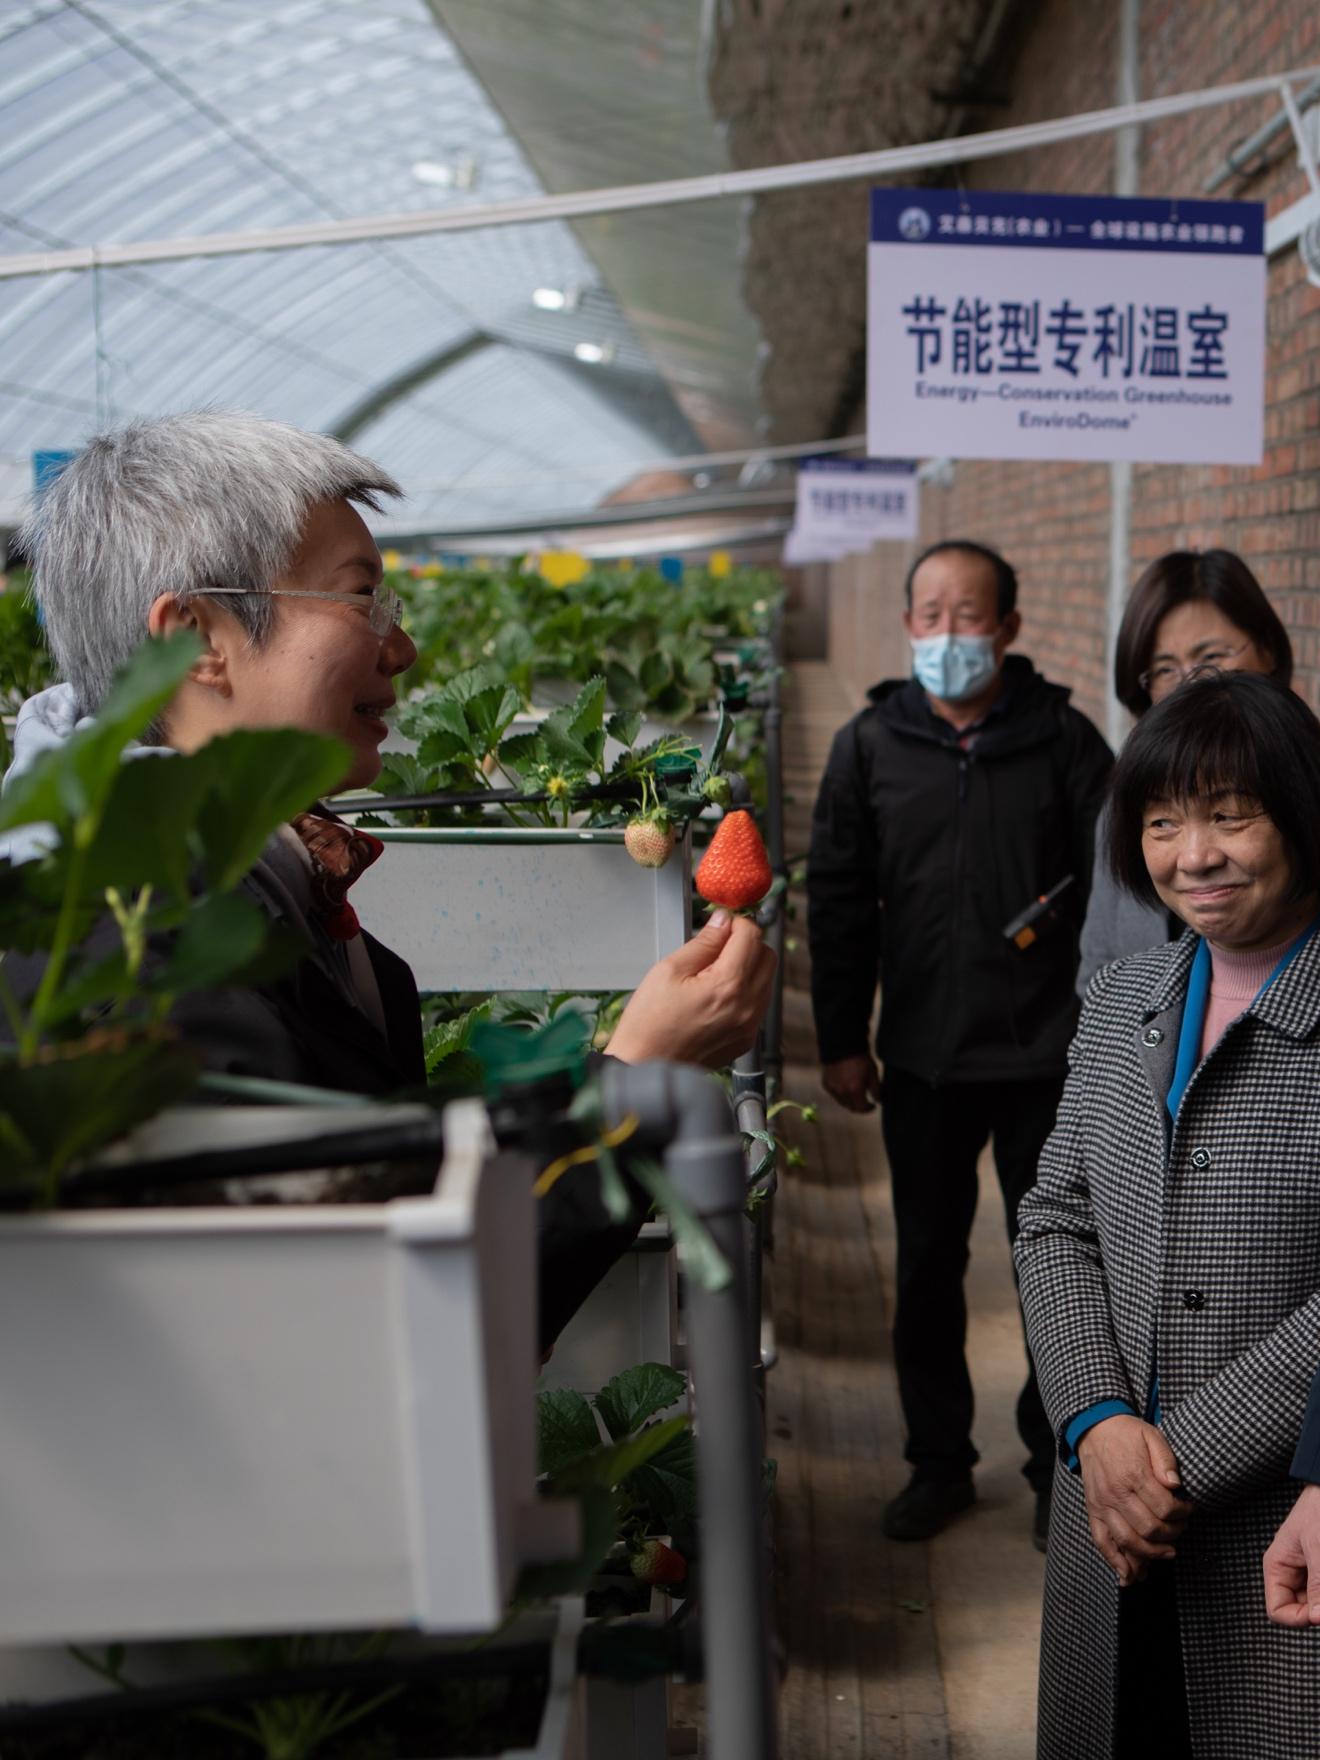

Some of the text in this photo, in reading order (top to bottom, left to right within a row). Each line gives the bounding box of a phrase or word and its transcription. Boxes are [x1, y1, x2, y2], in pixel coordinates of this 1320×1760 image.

[901, 294, 1230, 379] 节能型专利温室
[1124, 387, 1233, 407] Greenhouse
